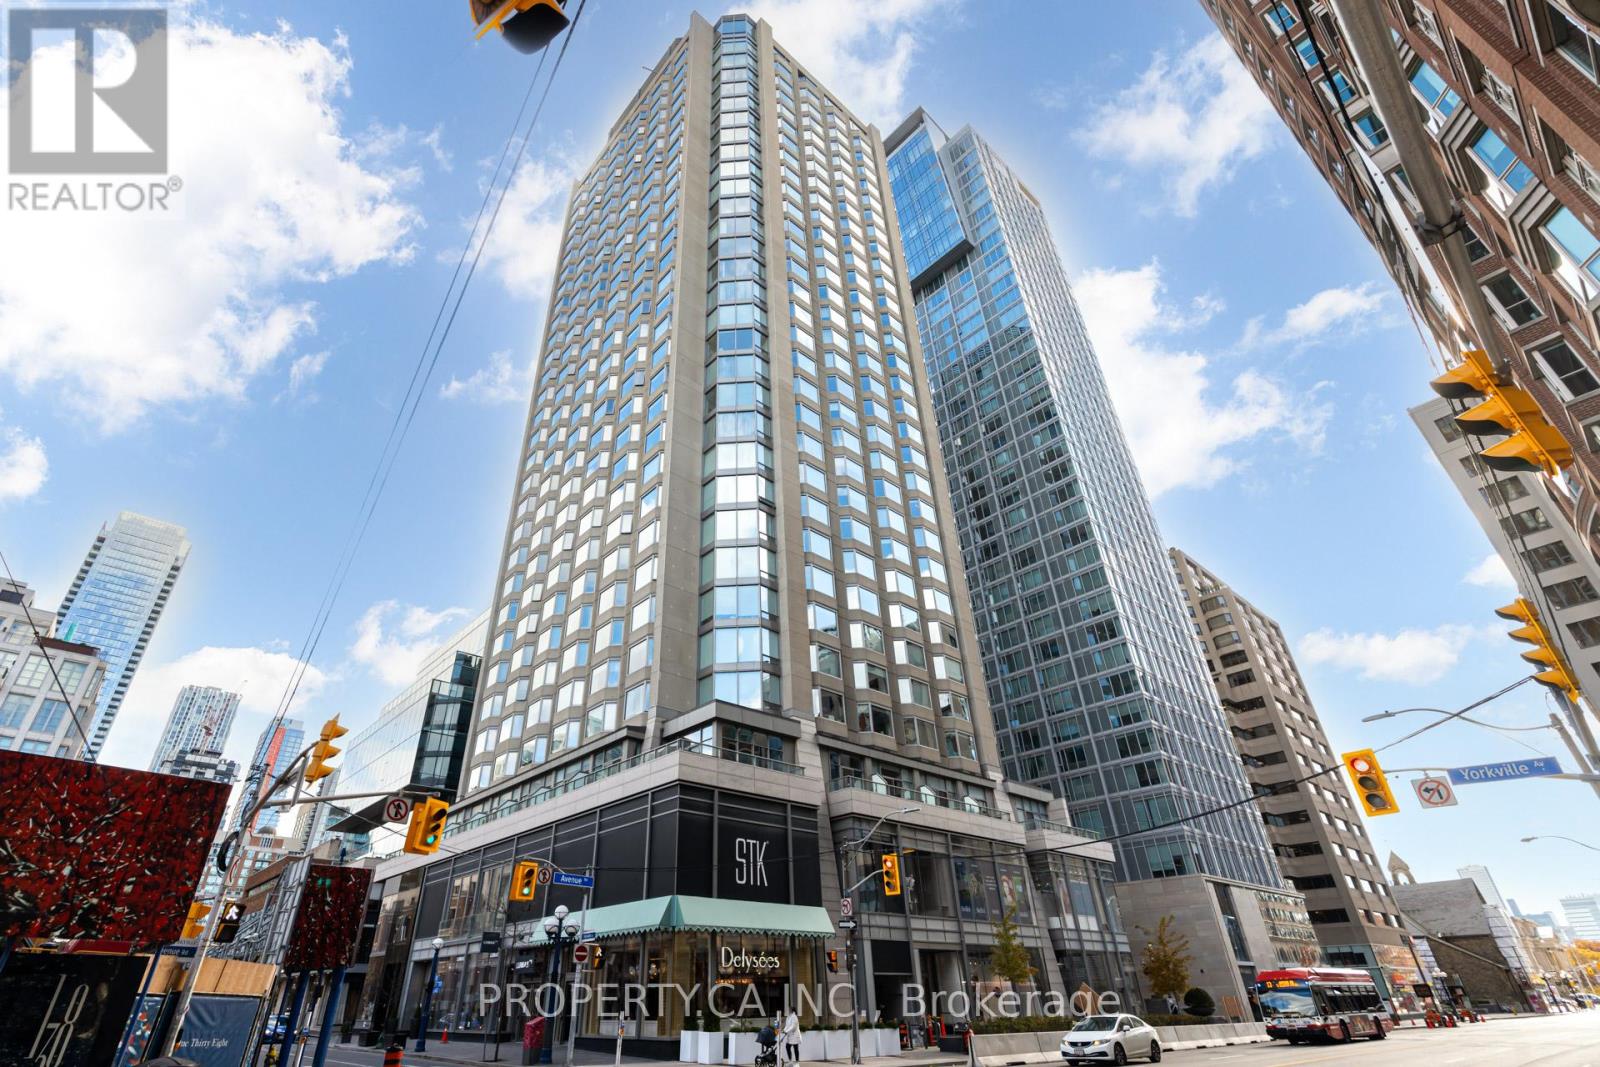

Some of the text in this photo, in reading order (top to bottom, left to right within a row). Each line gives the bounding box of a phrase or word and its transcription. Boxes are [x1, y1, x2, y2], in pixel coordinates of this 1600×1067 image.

[1458, 763, 1529, 781] Yorkville
[735, 837, 769, 887] STK
[560, 874, 583, 885] Avenue
[721, 946, 780, 973] Delysées
[211, 1037, 229, 1048] Eight
